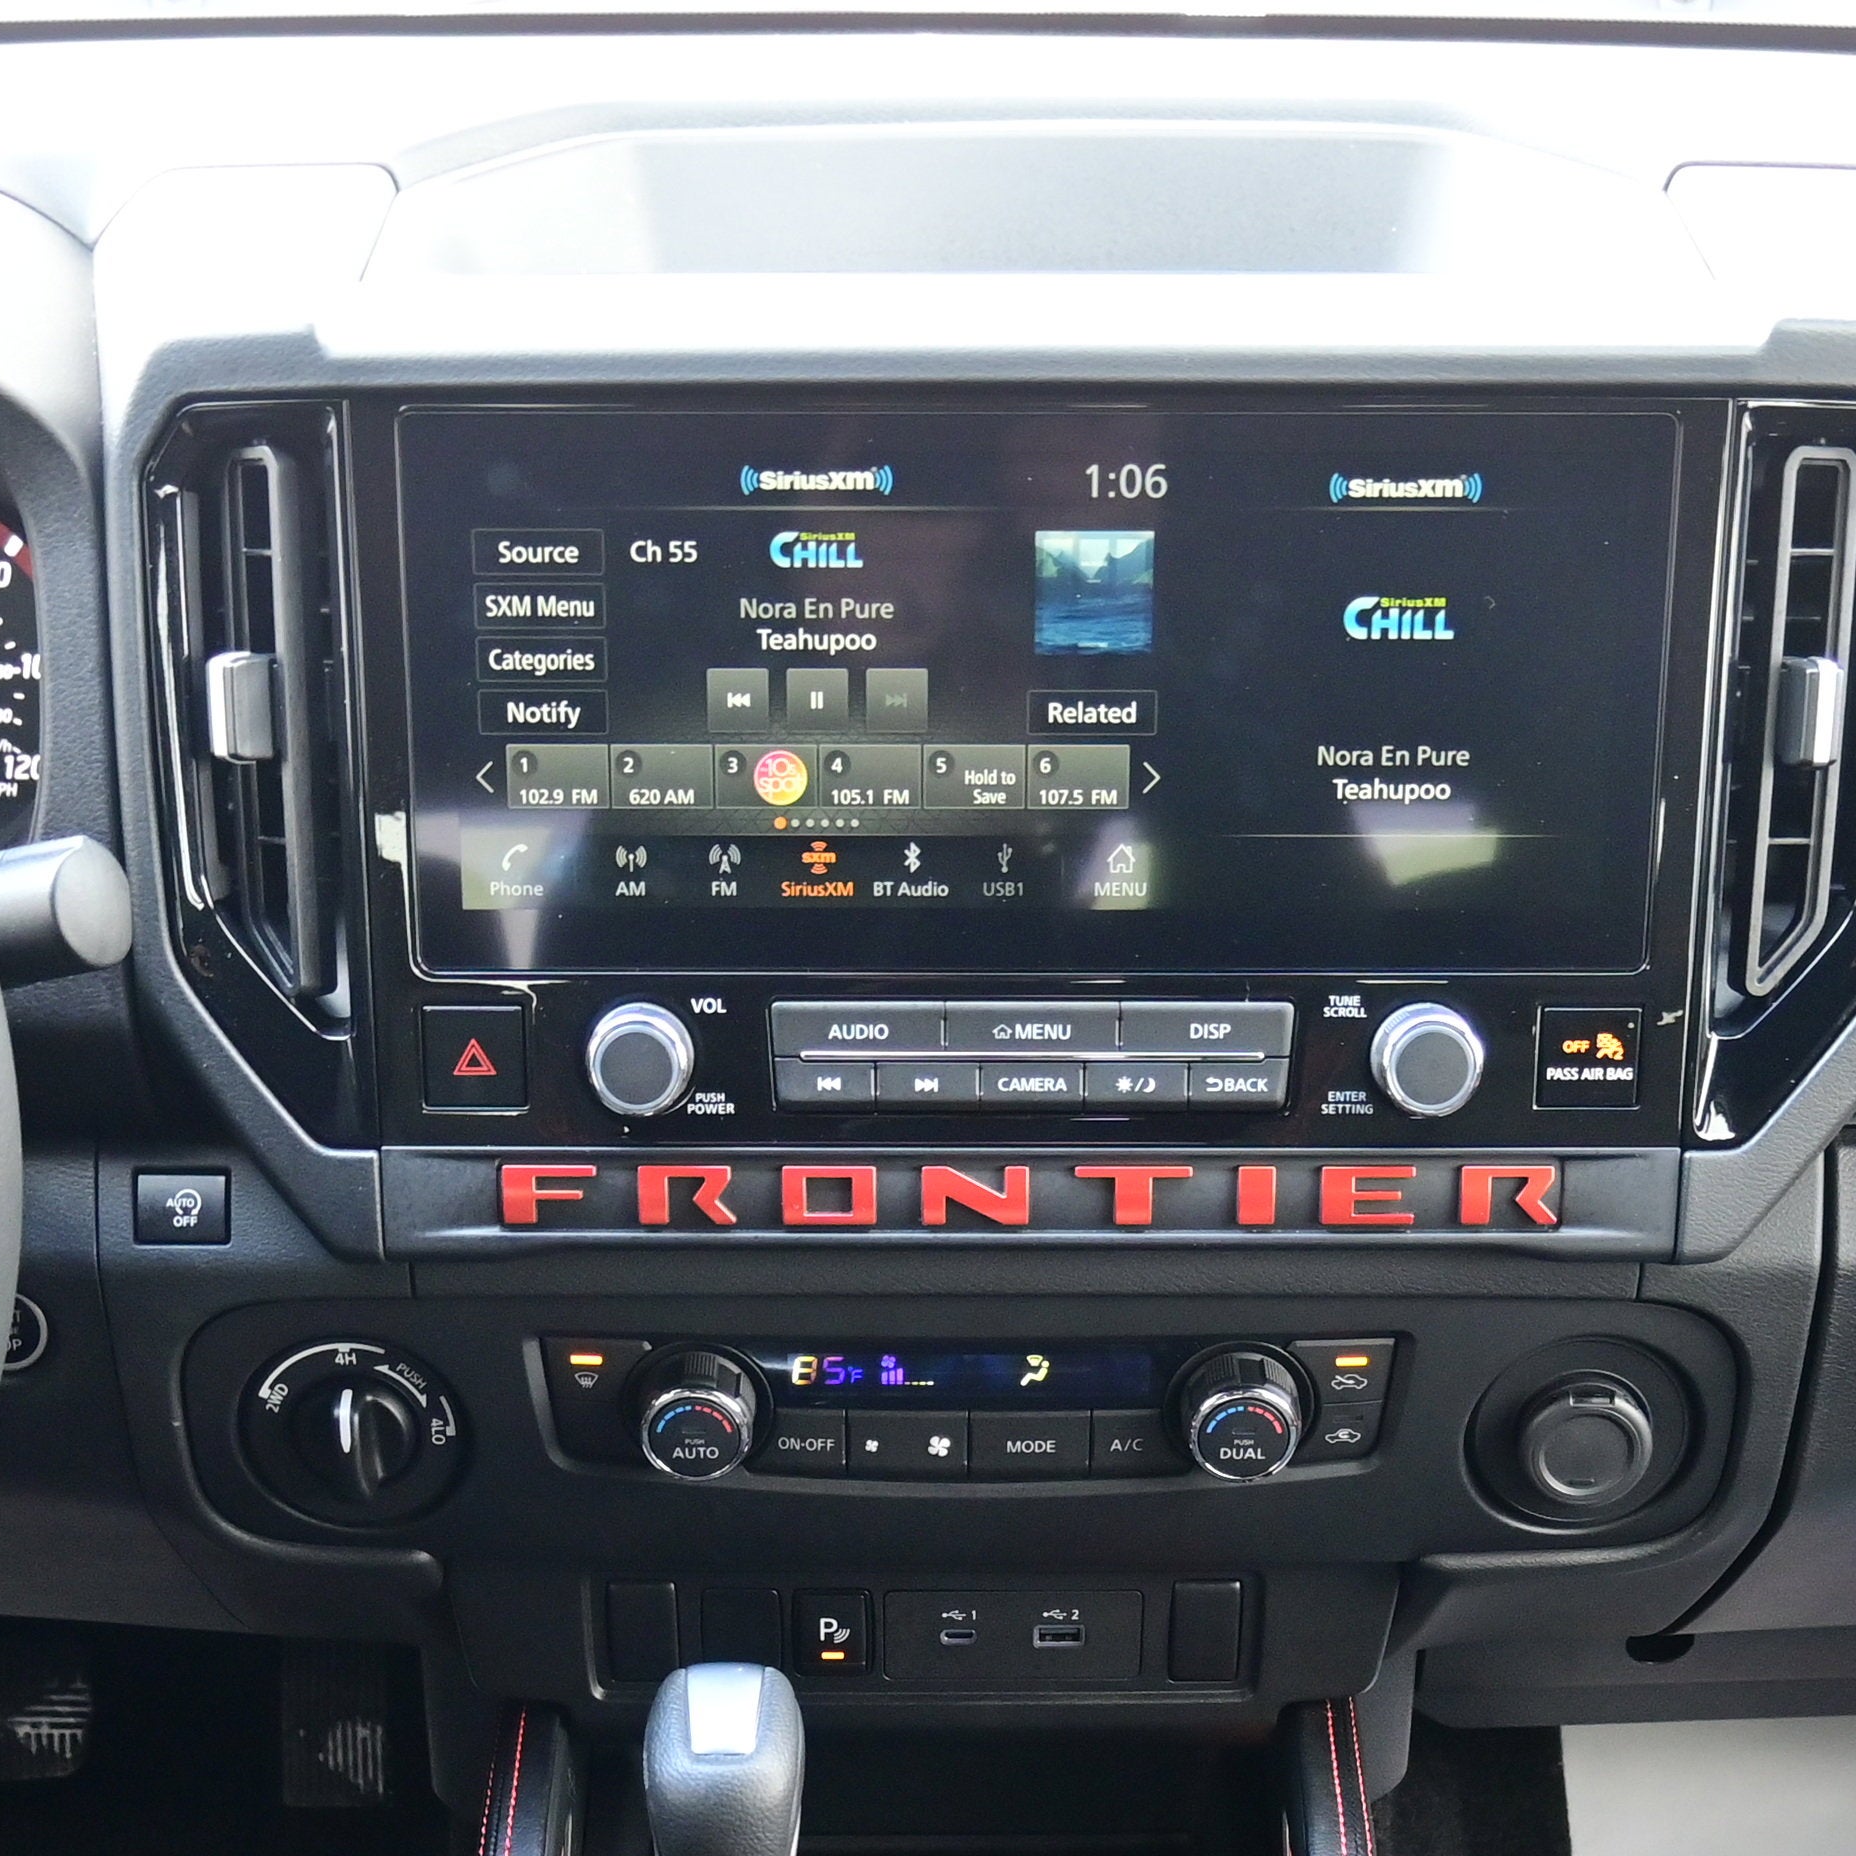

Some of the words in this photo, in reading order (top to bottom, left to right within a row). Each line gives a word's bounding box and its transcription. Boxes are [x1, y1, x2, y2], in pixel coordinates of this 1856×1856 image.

[1085, 463, 1168, 500] 1:06
[498, 541, 580, 565] Source
[630, 540, 664, 564] Ch
[668, 541, 698, 564] 55
[485, 594, 533, 619] SXM
[537, 594, 596, 619] Menu
[740, 597, 798, 620] Nora
[804, 597, 834, 620] En
[840, 597, 895, 620] Pure
[755, 626, 878, 657] Teahupoo
[488, 648, 596, 675] Categories
[505, 701, 582, 729] Notify
[1047, 700, 1138, 726] Related
[519, 757, 529, 774] 1
[623, 757, 635, 774] 2
[726, 757, 739, 774] 3
[830, 757, 844, 774] 4
[935, 757, 948, 774] 5
[1039, 757, 1051, 774] 6
[1316, 745, 1375, 768] Nora
[1380, 745, 1411, 768] En
[1416, 745, 1471, 768] Pure
[964, 768, 994, 787] Hold
[997, 770, 1017, 787] to
[519, 787, 565, 806] 102.9
[571, 787, 599, 806] FM
[629, 787, 661, 806] 620
[663, 787, 696, 806] AM
[831, 787, 875, 806] 105.1
[883, 787, 911, 806] FM
[972, 788, 1008, 805] Save
[1038, 787, 1085, 806] 107.5
[1090, 787, 1119, 806] FM
[1332, 777, 1453, 805] Teahupoo
[489, 880, 545, 898] Phone
[614, 880, 646, 898] AM
[711, 880, 738, 898] FM
[780, 880, 855, 898] SiriusXM
[872, 880, 897, 898] BT
[901, 880, 950, 898] Audio
[982, 880, 1026, 898] USB1
[1093, 880, 1148, 898] MENU
[690, 997, 727, 1015] VOL
[1328, 995, 1362, 1008] TUNE
[1322, 1006, 1368, 1019] SCROLL
[828, 1023, 890, 1041] AUDIO
[1014, 1022, 1072, 1041] MENU
[1189, 1022, 1232, 1041] DISP
[1562, 1039, 1591, 1054] OFF
[1546, 1066, 1580, 1081] PASS
[1580, 1066, 1605, 1081] AIR
[1606, 1066, 1634, 1081] BAG
[998, 1076, 1068, 1094] CAMERA
[1224, 1076, 1269, 1094] BACK
[694, 1092, 726, 1104] PUSH
[1327, 1090, 1367, 1103] ENTER
[686, 1103, 736, 1116] POWER
[1320, 1102, 1374, 1116] SETTING
[166, 1197, 195, 1209] AUTO
[500, 1164, 1559, 1227] FRONTIER
[172, 1216, 199, 1228] OFF
[334, 1352, 357, 1367] 4H
[395, 1361, 428, 1391] PUSH
[264, 1381, 290, 1414] 2WD
[430, 1416, 446, 1446] 4LO
[683, 1437, 706, 1447] PUSH
[1005, 1438, 1057, 1454] MODE
[1109, 1437, 1144, 1454] A/C
[1233, 1438, 1255, 1448] PUSH
[671, 1445, 720, 1462] AUTO
[1219, 1446, 1266, 1462] DUAL
[818, 1617, 837, 1641] P
